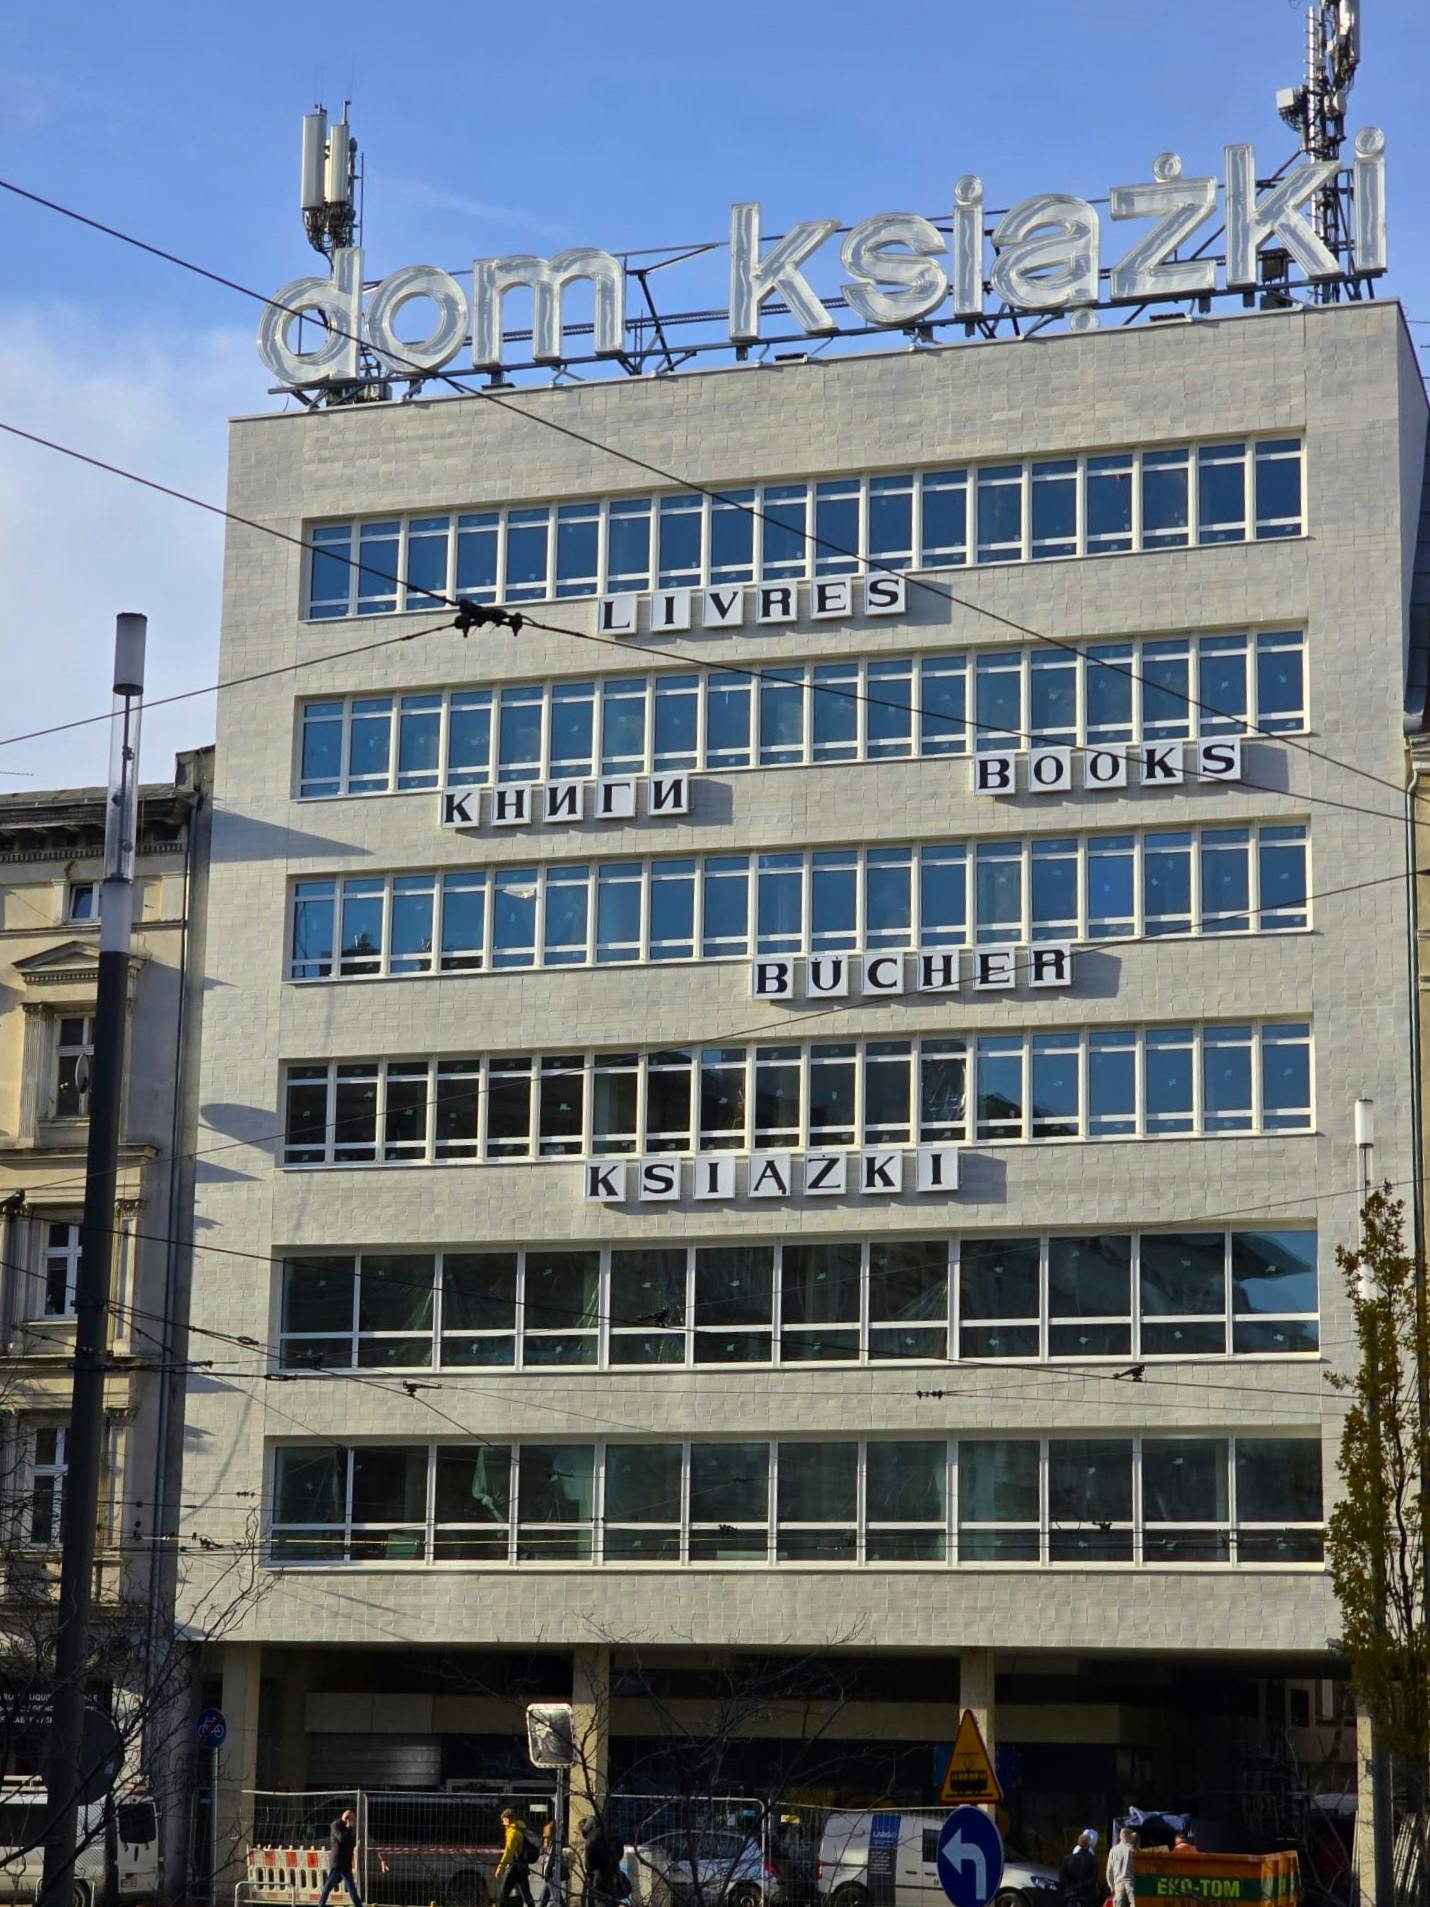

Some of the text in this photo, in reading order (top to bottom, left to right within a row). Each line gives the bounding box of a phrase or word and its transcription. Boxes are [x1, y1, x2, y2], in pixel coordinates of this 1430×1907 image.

[257, 246, 626, 386] dom
[602, 579, 902, 631] LIVRES
[978, 742, 1238, 793] BOOKS
[443, 779, 686, 826] КНИГИ
[757, 948, 1066, 995] BÜCHER
[590, 1153, 946, 1200] KSIĄŻKI
[1157, 1878, 1240, 1898] EKO-TOM
